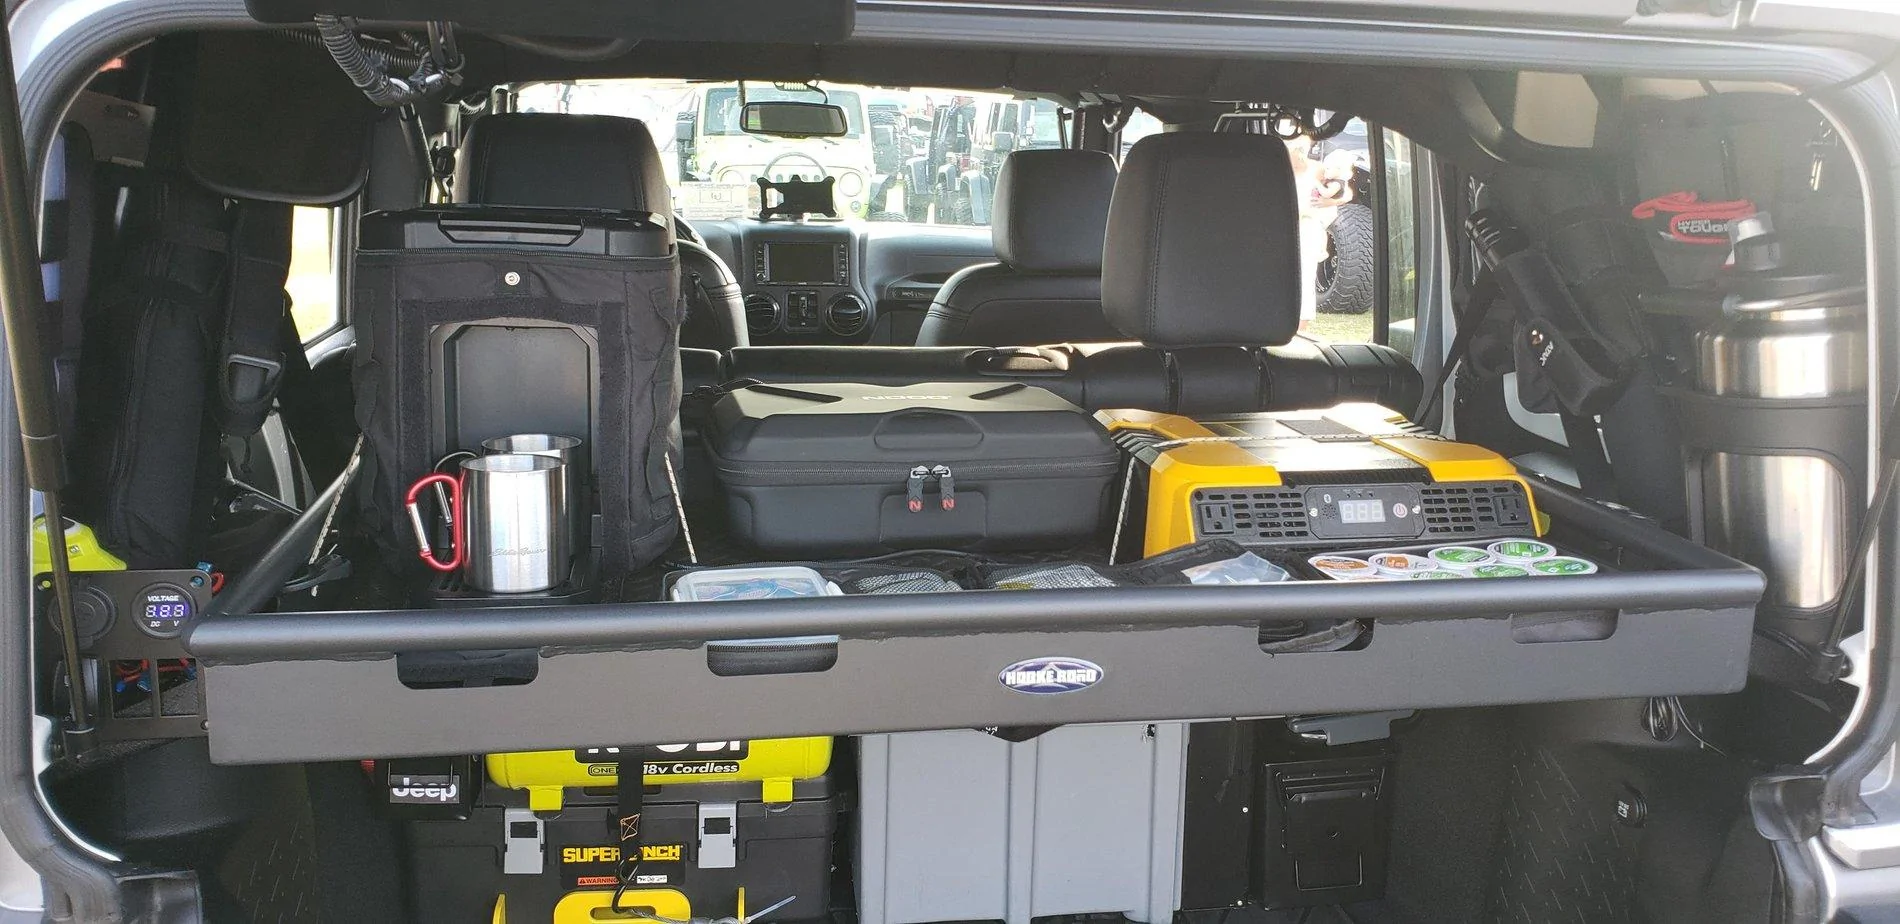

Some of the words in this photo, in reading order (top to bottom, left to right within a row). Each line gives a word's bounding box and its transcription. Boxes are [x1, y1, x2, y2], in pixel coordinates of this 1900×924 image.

[150, 620, 161, 628] DC
[1005, 670, 1054, 685] HOOKE
[672, 762, 738, 774] Cordless
[392, 777, 457, 802] Jeep
